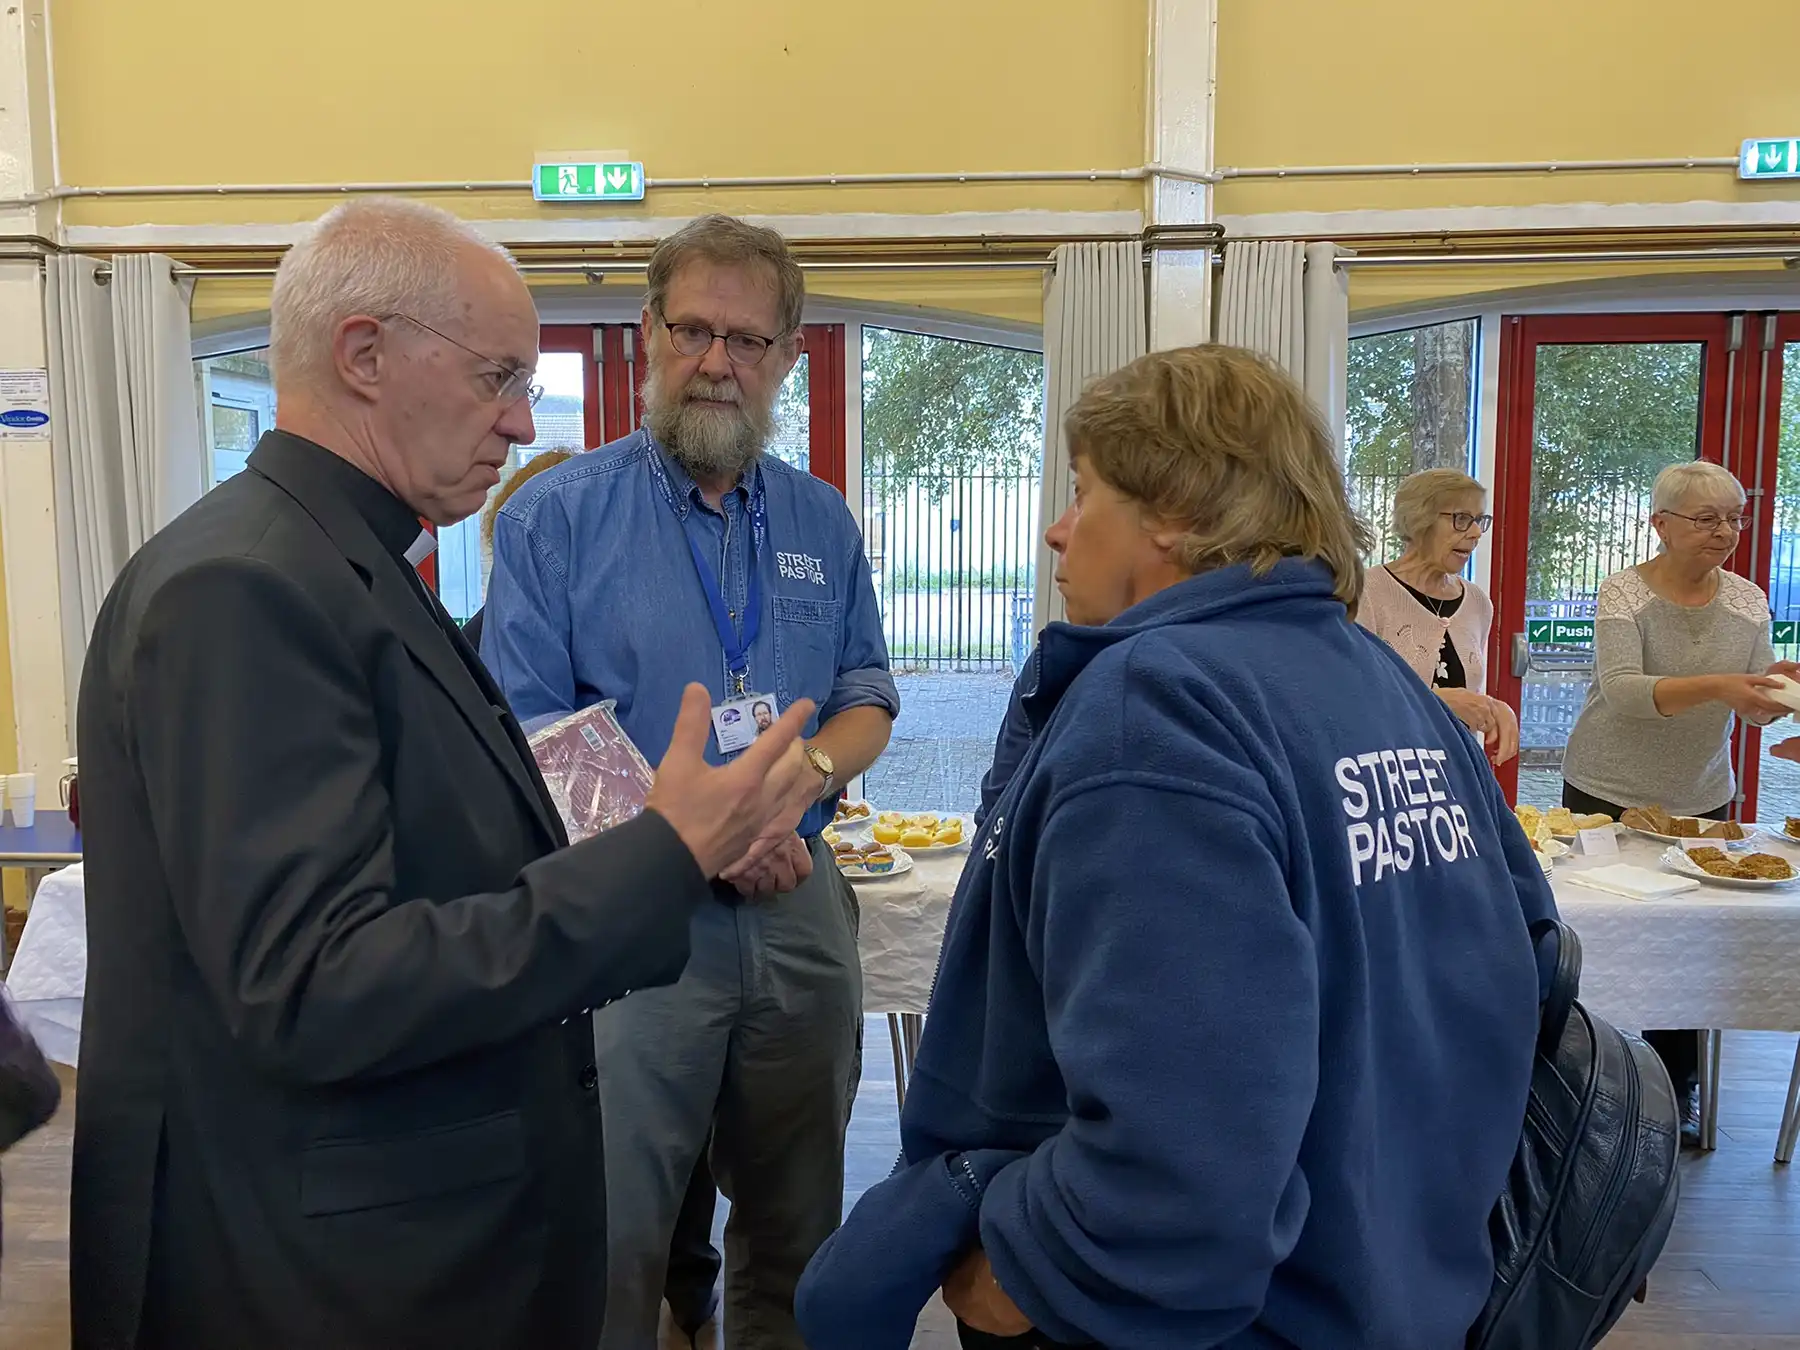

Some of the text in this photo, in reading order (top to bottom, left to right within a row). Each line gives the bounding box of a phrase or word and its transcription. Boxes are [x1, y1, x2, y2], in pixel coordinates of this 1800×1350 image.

[647, 452, 657, 475] PASTORS
[651, 449, 662, 468] STREET
[776, 551, 822, 571] STREET
[779, 565, 826, 585] PASTOR
[1556, 625, 1593, 637] Push
[1334, 748, 1457, 818] STREET
[1346, 804, 1479, 886] PASTOR
